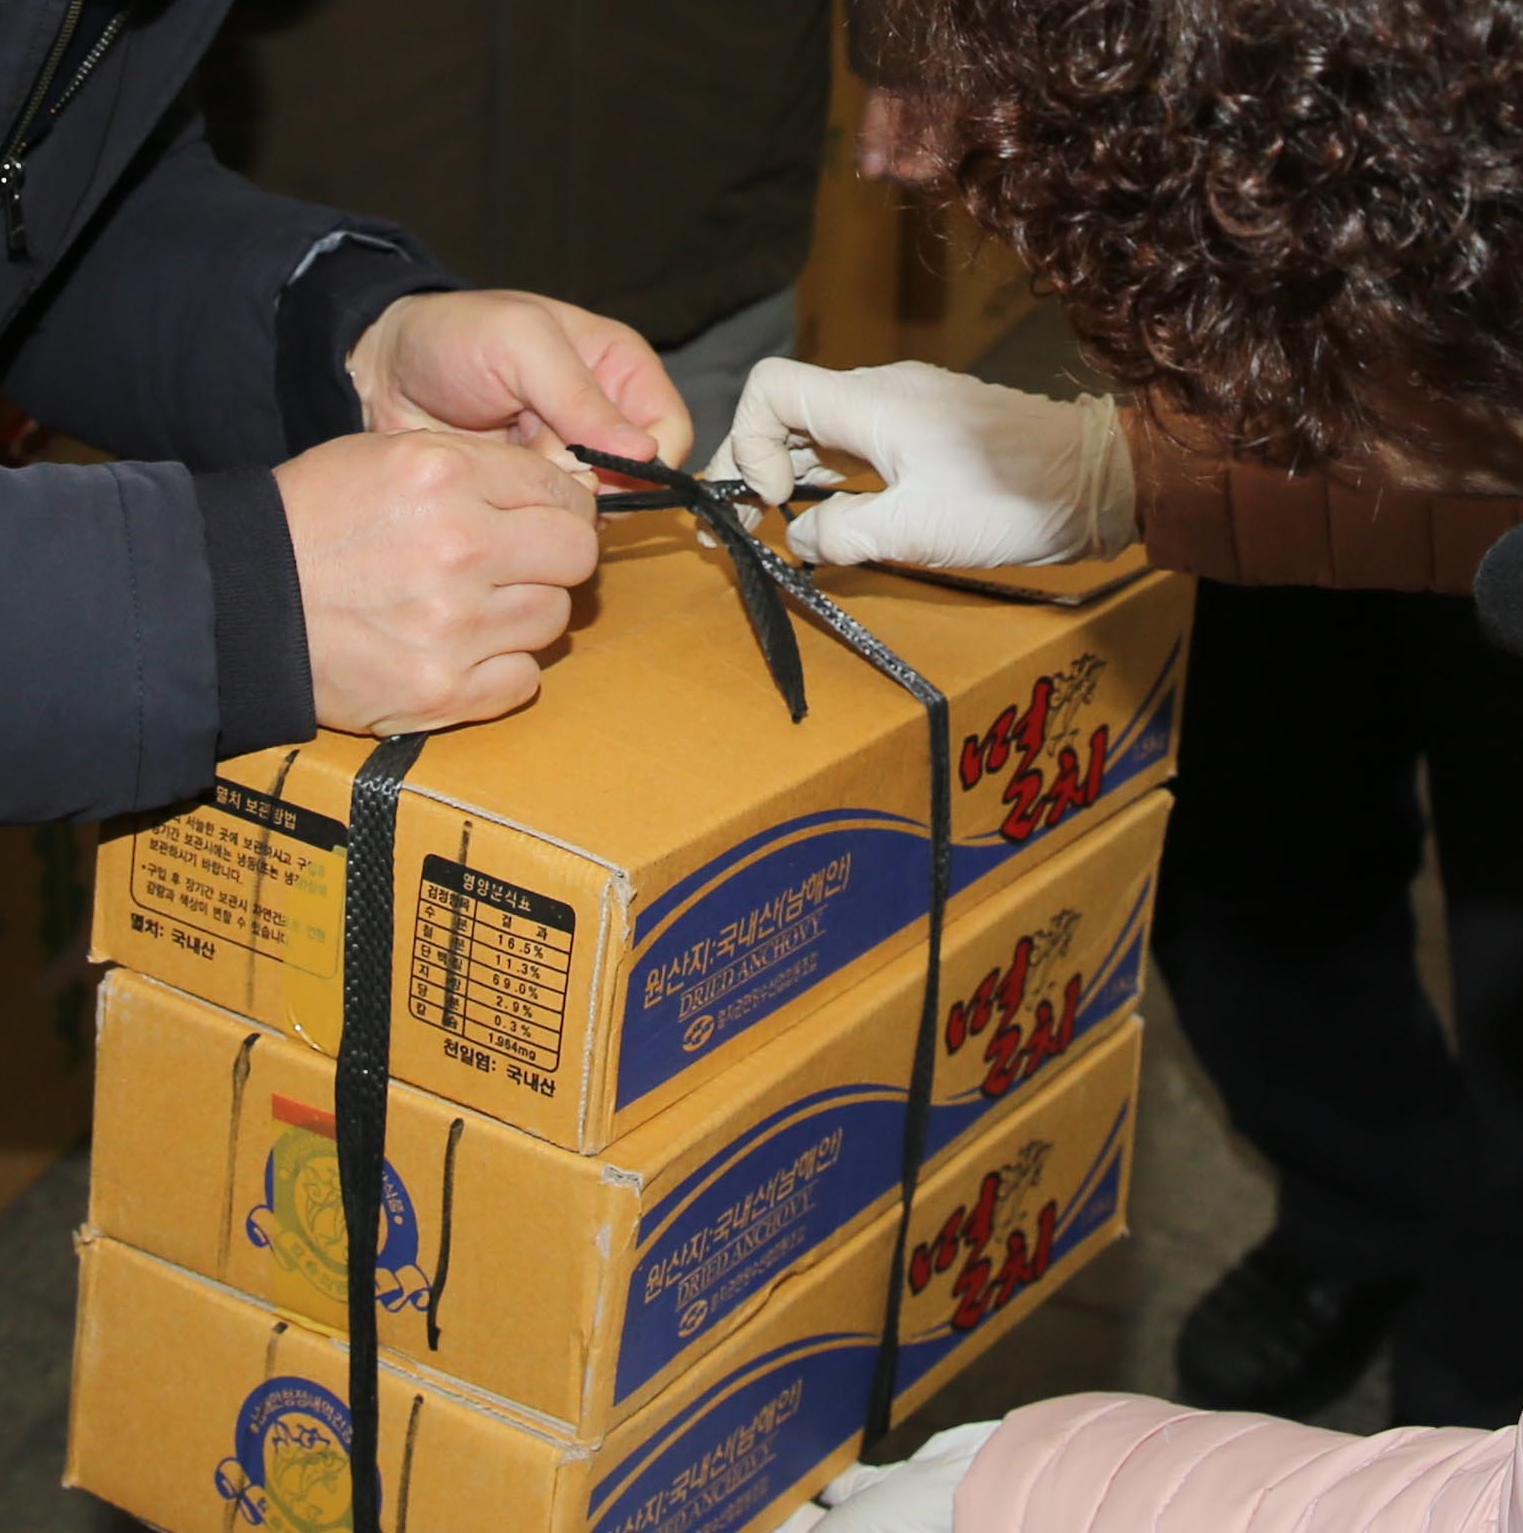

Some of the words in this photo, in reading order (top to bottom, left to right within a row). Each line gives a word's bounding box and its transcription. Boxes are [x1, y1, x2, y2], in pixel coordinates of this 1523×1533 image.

[216, 785, 241, 811] 멸치
[245, 798, 297, 830] 보관방법
[186, 815, 215, 837] 서늘한
[219, 827, 239, 846] 곳에
[149, 837, 197, 867] 보관하시기
[184, 833, 232, 862] 보관시에는
[186, 877, 214, 900] 장기간
[219, 891, 248, 913] 보관시
[237, 916, 246, 930] 수
[171, 928, 215, 960] 국내산
[679, 967, 735, 1019] DRIED
[736, 916, 823, 982] ANCHOVY
[506, 1063, 556, 1098] 국내산
